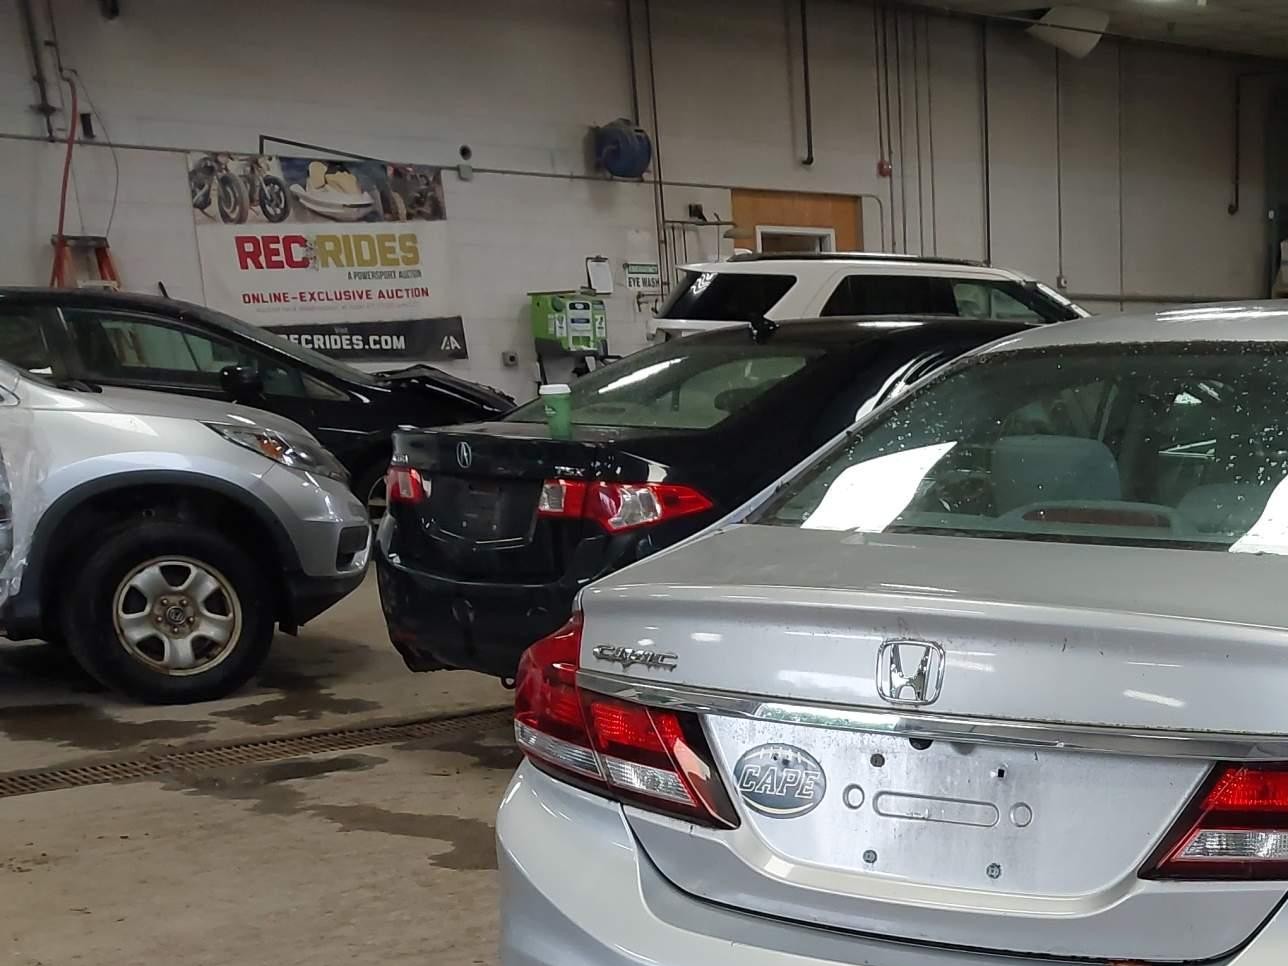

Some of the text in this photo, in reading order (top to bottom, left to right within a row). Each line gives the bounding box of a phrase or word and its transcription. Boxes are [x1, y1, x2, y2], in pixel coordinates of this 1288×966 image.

[235, 233, 420, 270] REC RIDES
[353, 270, 397, 280] POWERSPORT
[628, 277, 641, 288] EYE
[242, 287, 430, 304] ONLINE-EXCLUSIVE AUCTION
[555, 465, 585, 477] TSX
[738, 764, 821, 799] CAPE
